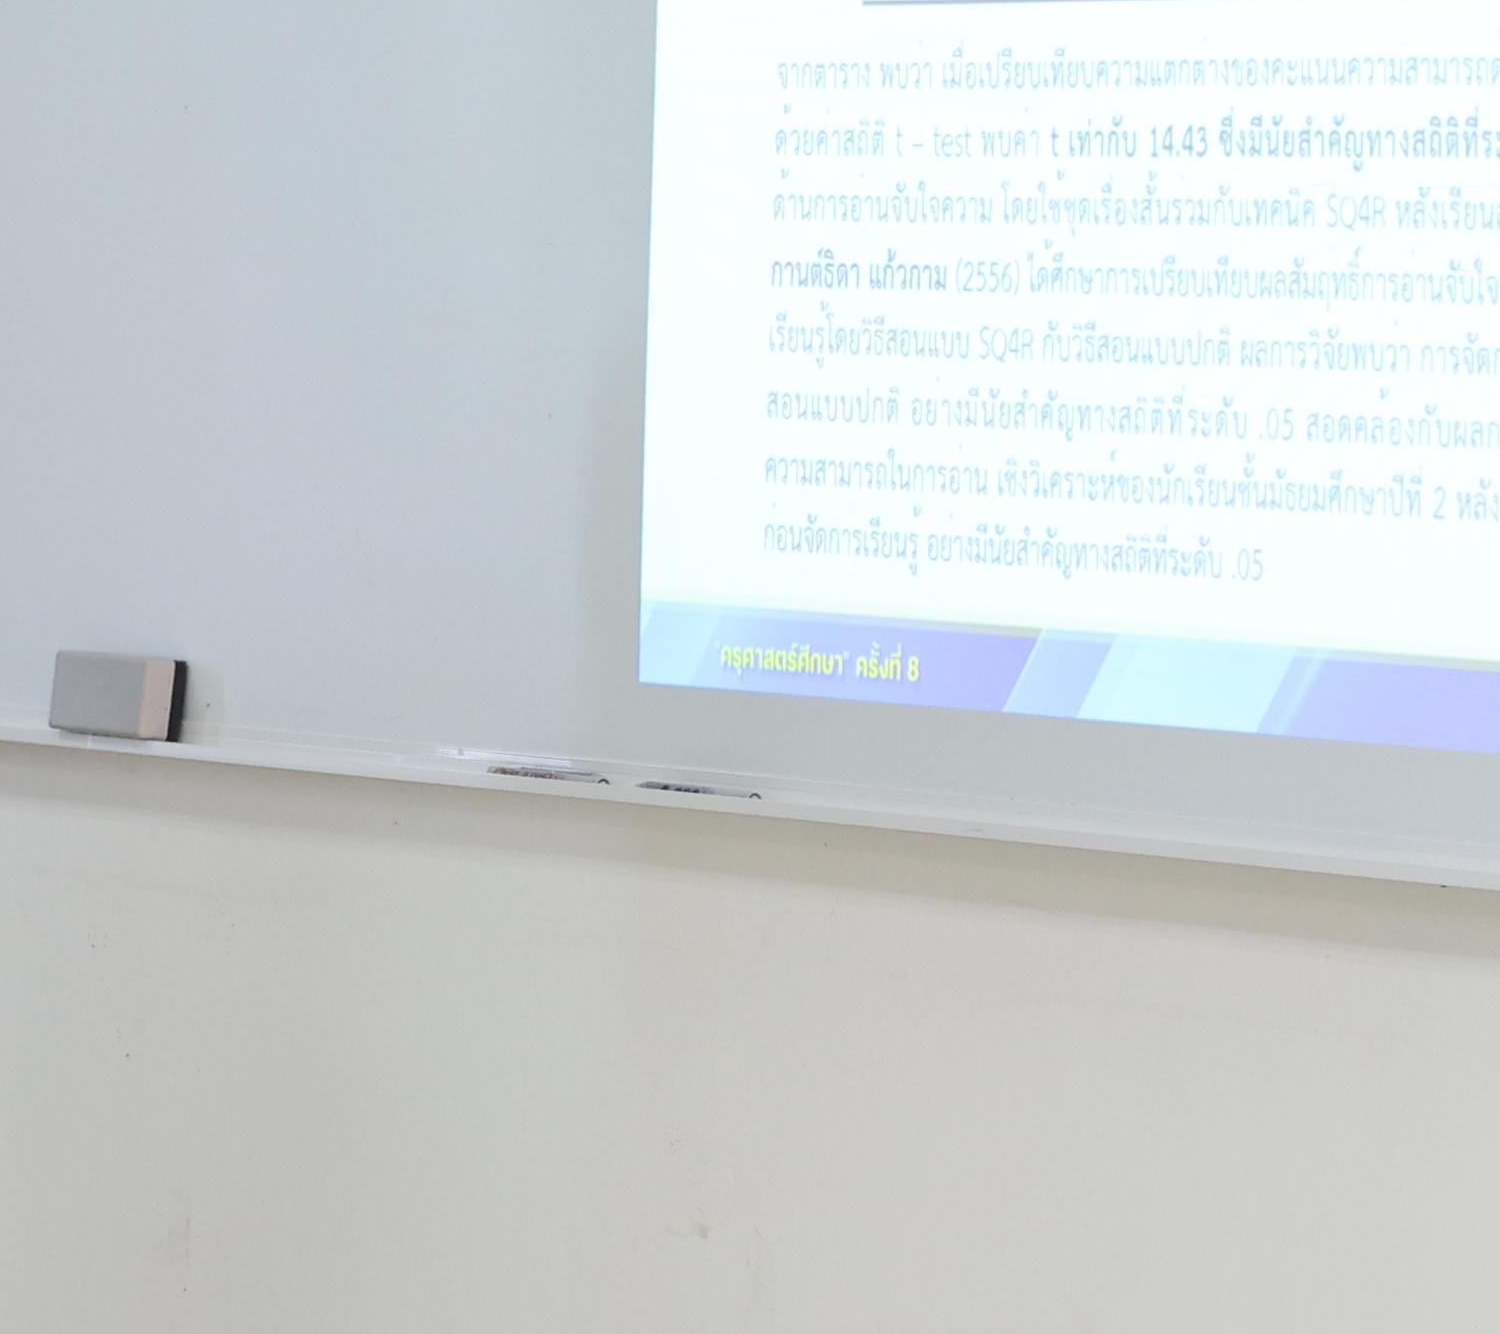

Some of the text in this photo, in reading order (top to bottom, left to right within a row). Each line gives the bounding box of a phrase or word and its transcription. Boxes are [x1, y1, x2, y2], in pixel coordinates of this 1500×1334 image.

[777, 62, 871, 89] จากตาราง
[933, 128, 972, 158] test
[1068, 114, 1137, 159] เท่ากับ
[1150, 123, 1209, 159] 14.43
[1327, 192, 1385, 232] SQ4R
[955, 258, 1020, 296] (2556)
[978, 325, 1034, 363] SQ4R
[766, 386, 900, 424] สอนแบบปกติ
[1257, 407, 1294, 442] .05
[1432, 485, 1446, 520] 2
[1232, 548, 1263, 582] .05
[856, 641, 901, 682] ครั้งที่
[906, 655, 920, 682] 8
